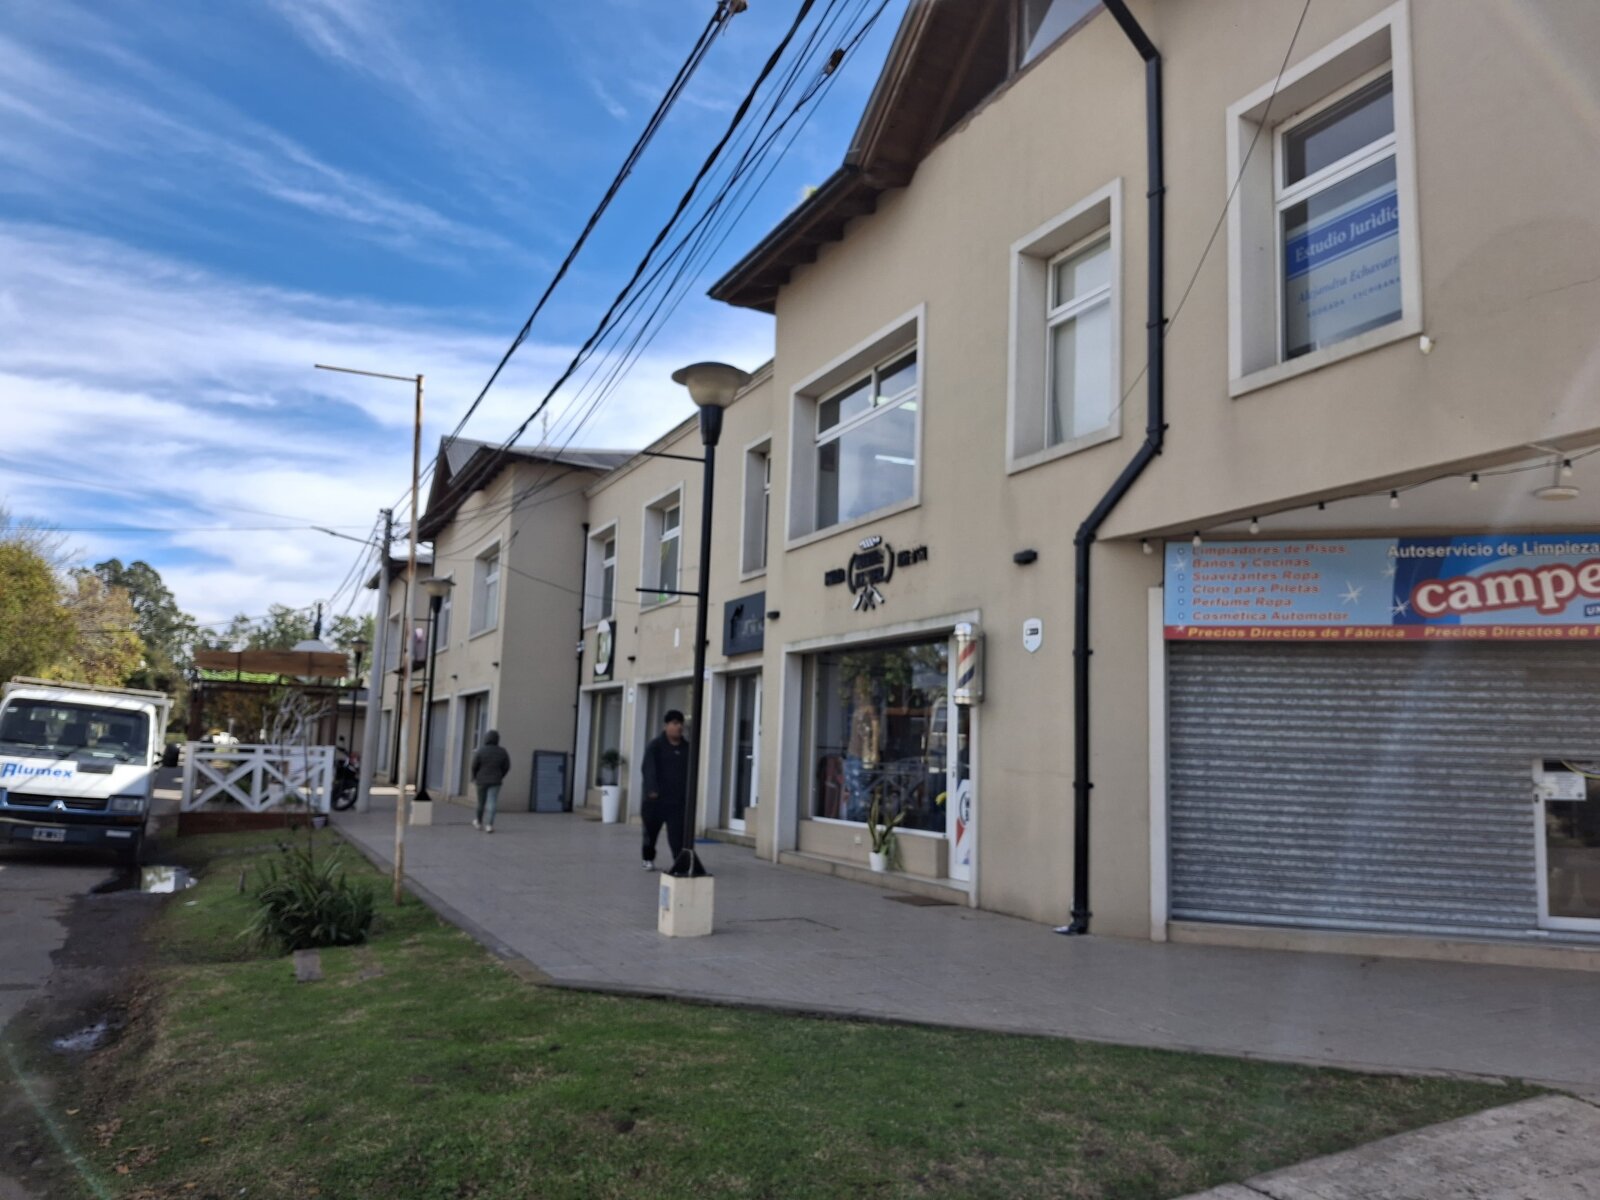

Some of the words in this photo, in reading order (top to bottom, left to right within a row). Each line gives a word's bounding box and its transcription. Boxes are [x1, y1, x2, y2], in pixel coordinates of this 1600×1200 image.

[1296, 231, 1347, 263] Estudio
[1284, 545, 1300, 554] de
[1387, 543, 1493, 558] Autoservicio
[1497, 542, 1518, 556] de
[1522, 541, 1600, 557] Limpieza
[1240, 560, 1248, 570] y
[1252, 558, 1311, 568] Cocinas
[1192, 572, 1278, 581] Suavizantes
[1282, 571, 1320, 581] Ropa
[1192, 585, 1230, 594] Cloro
[1234, 586, 1265, 595] para
[1271, 584, 1320, 594] Piletas
[1192, 598, 1250, 607] Perfume
[1255, 597, 1291, 608] Ropa
[1271, 611, 1349, 620] Automotor
[1187, 627, 1246, 638] Precios
[1250, 627, 1316, 638] Directos
[1320, 627, 1340, 638] de
[1424, 626, 1487, 638] Precios
[1492, 626, 1562, 638] Directos
[1568, 626, 1589, 637] de
[1, 763, 73, 778] Alumex
